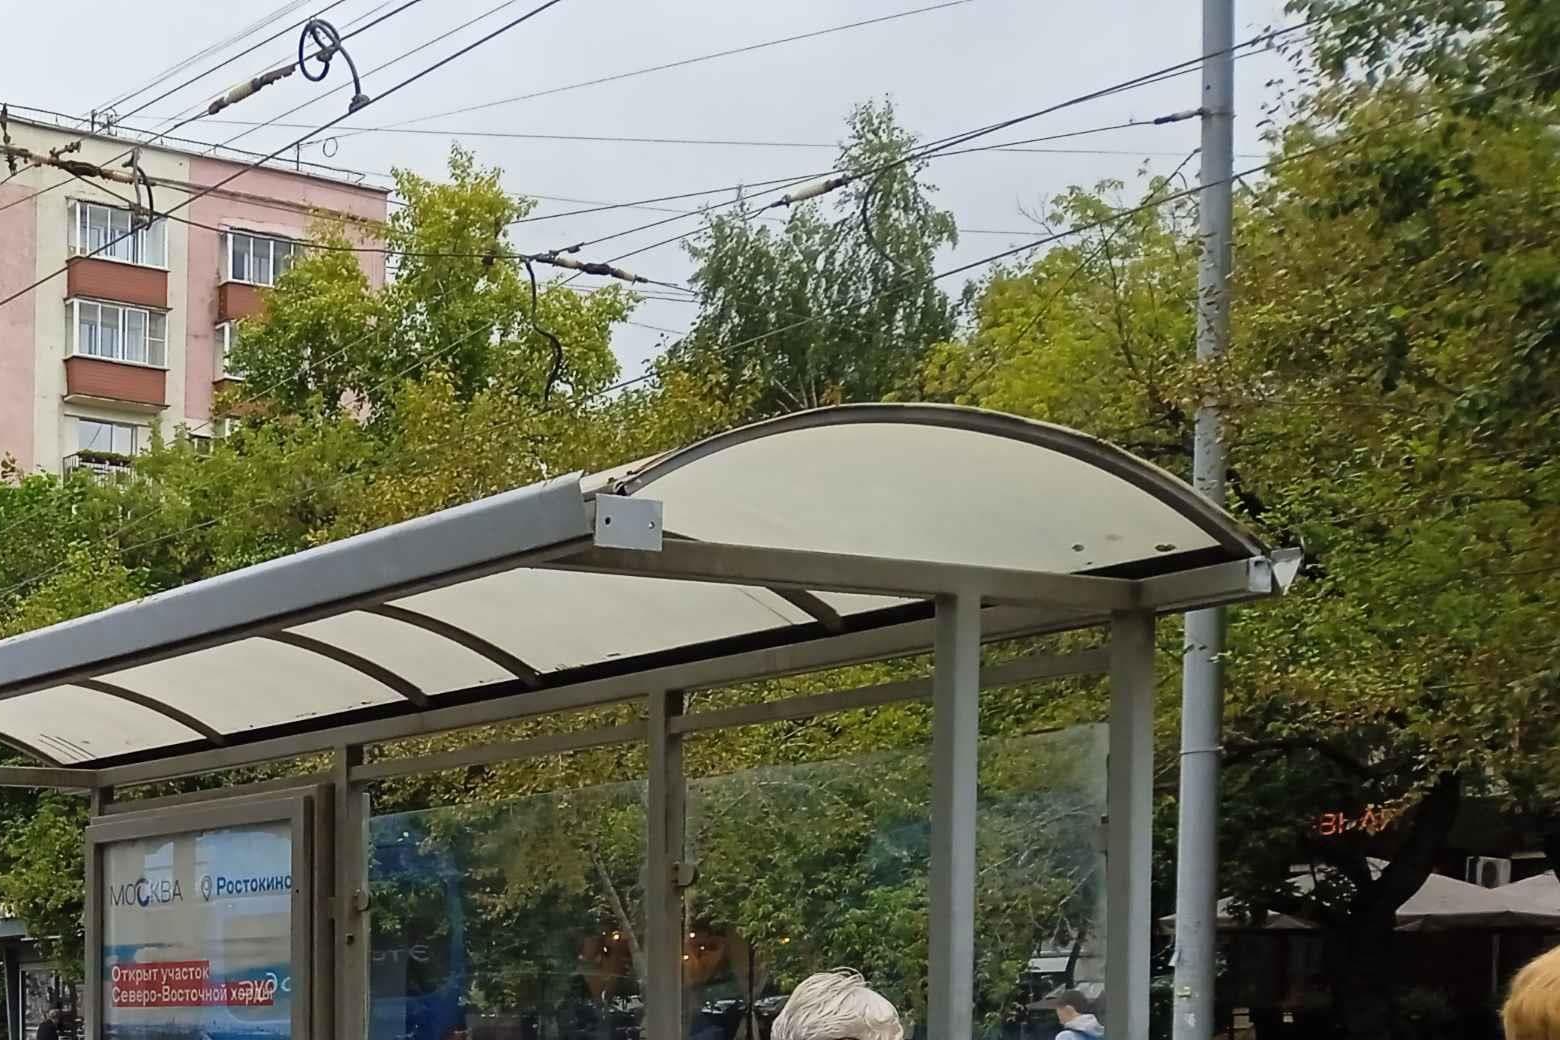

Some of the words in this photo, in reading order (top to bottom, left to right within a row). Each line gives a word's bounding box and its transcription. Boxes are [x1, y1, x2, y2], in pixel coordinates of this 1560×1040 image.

[110, 878, 184, 907] МОСКВА
[111, 966, 158, 985] Открыт
[160, 965, 210, 984] участок
[111, 983, 228, 1006] Северо-Восточной
